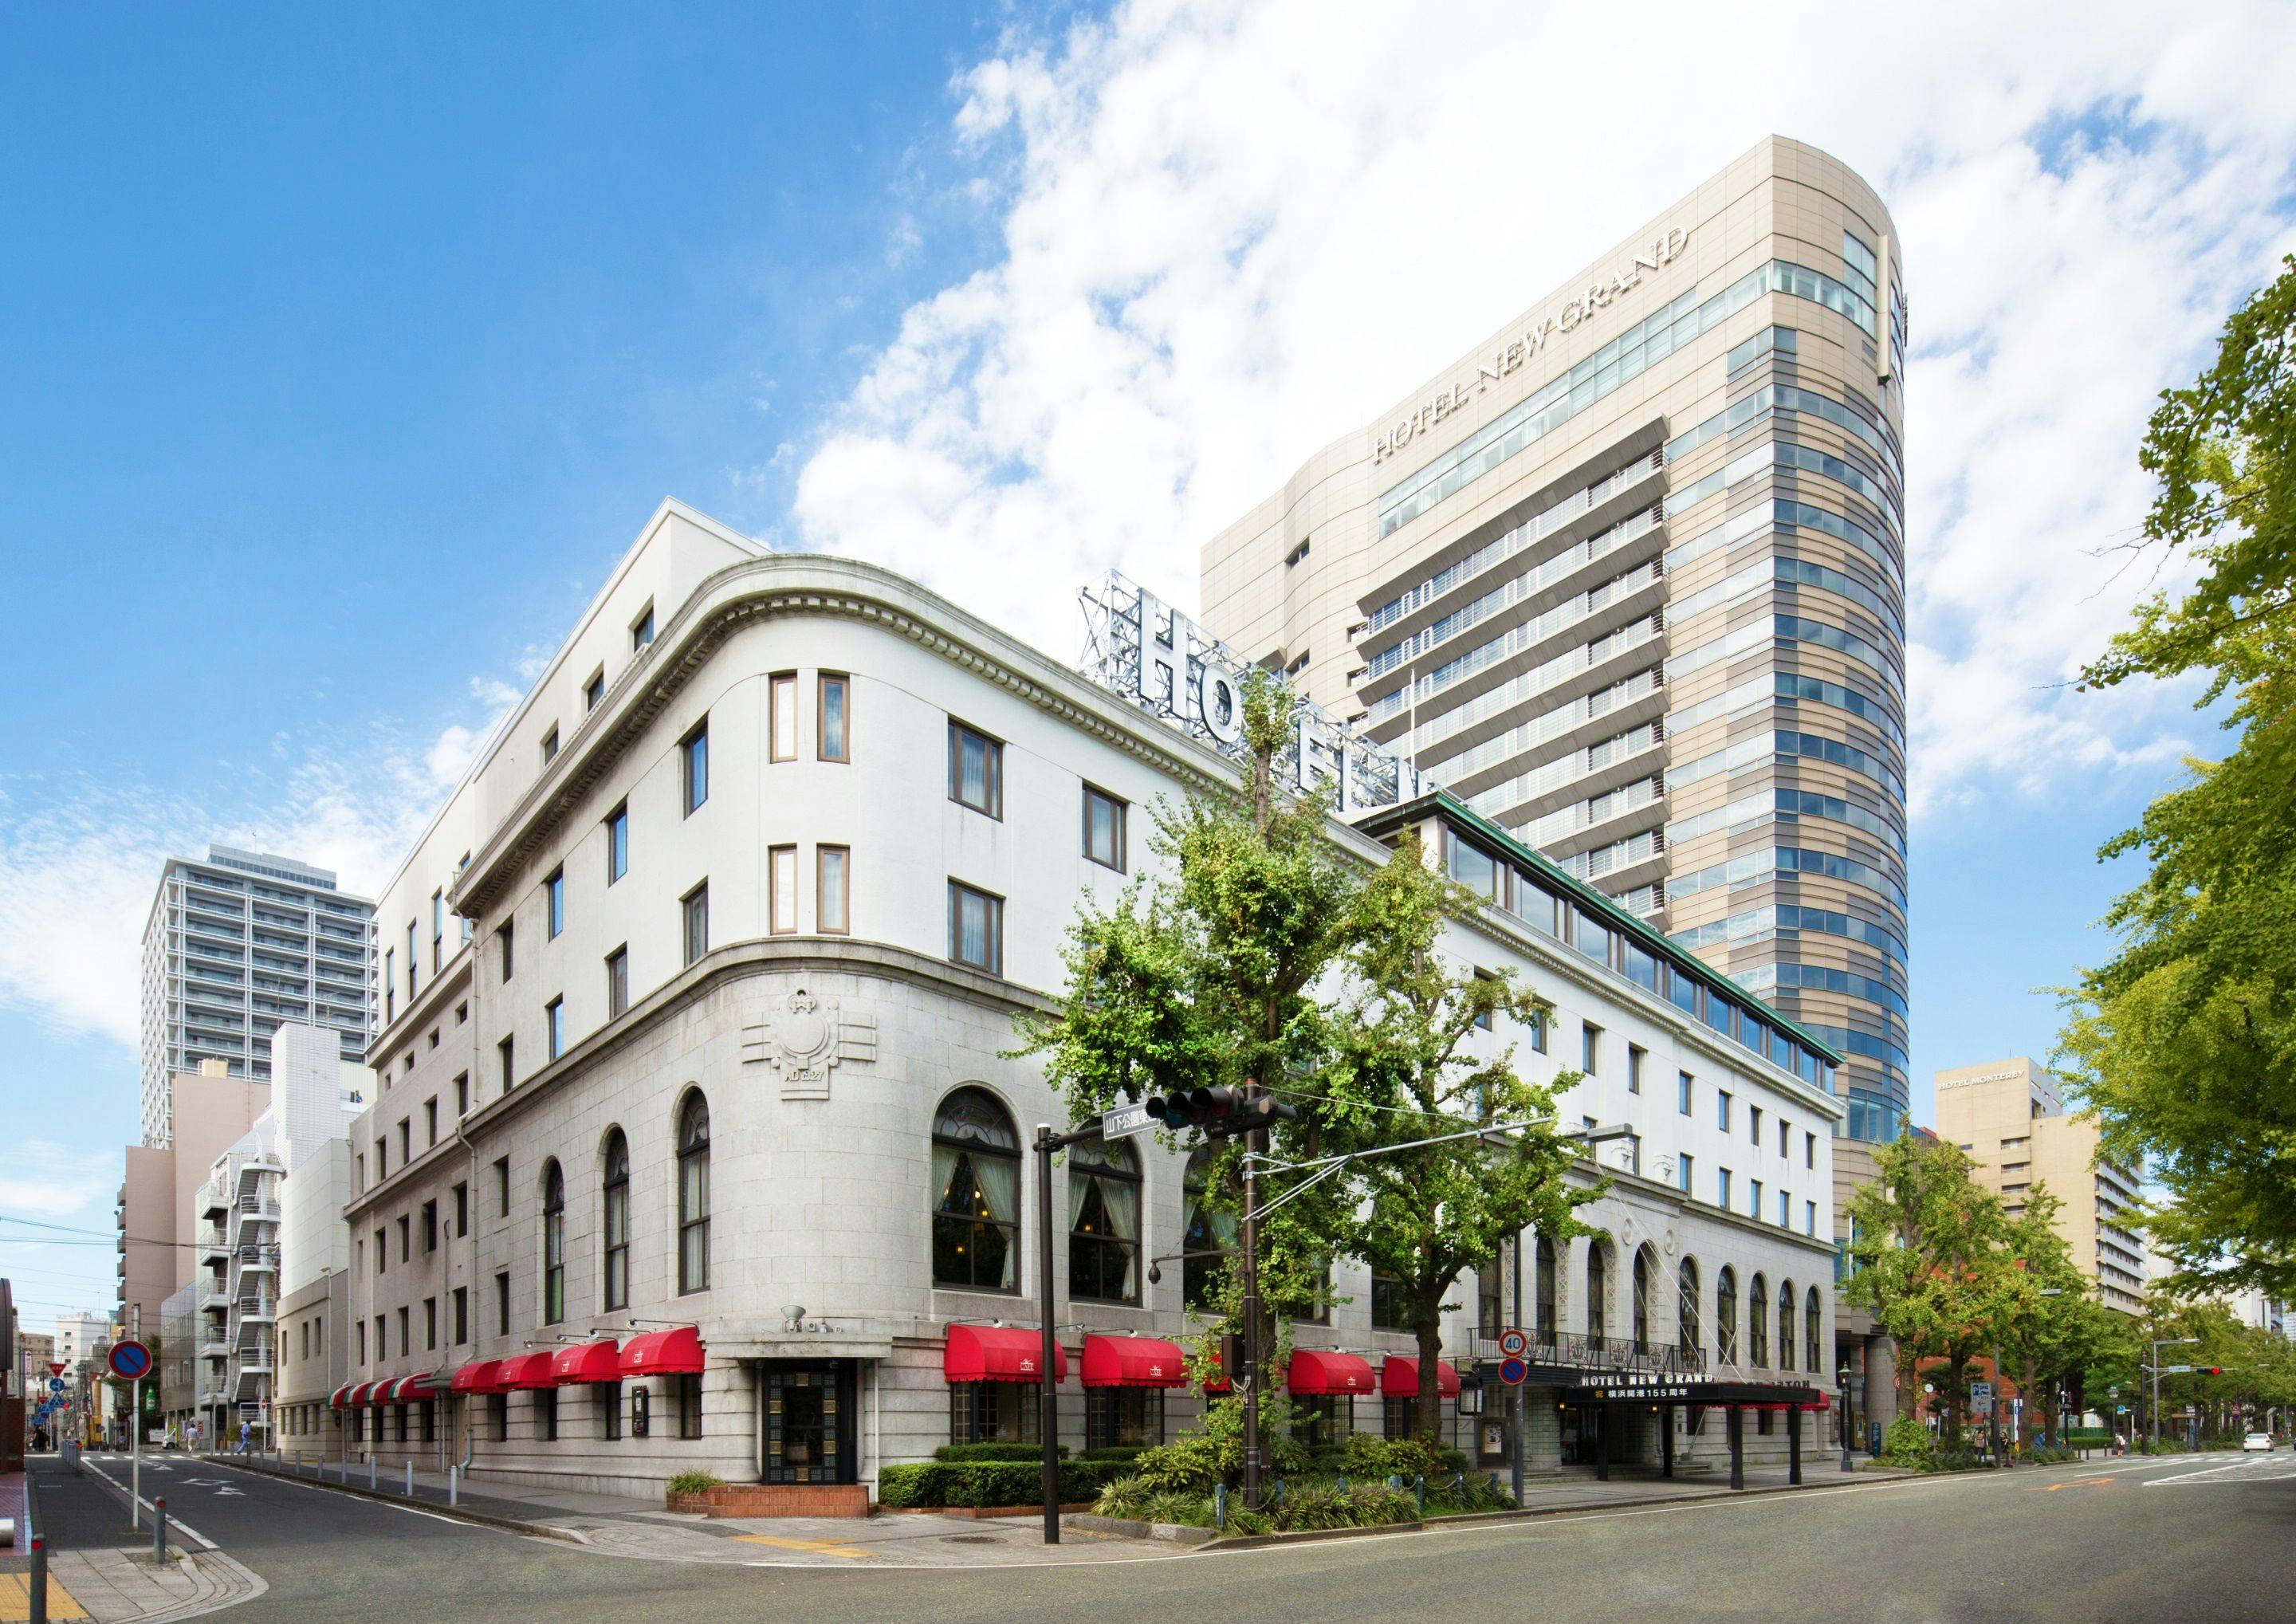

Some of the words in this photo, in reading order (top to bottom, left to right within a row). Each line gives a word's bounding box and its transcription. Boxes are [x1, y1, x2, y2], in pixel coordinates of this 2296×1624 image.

[1372, 383, 1469, 466] HOTEL
[1476, 316, 1552, 393] NEW
[1556, 224, 1689, 334] GRAND
[1138, 587, 1363, 815] HOEL
[1938, 1079, 1970, 1091] HOTEL
[1972, 1069, 2024, 1085] MONTEREY
[1505, 1337, 1521, 1350] 40
[1582, 1375, 1623, 1386] HOTEL
[1629, 1374, 1658, 1385] NEW
[1665, 1371, 1712, 1384] GRAND
